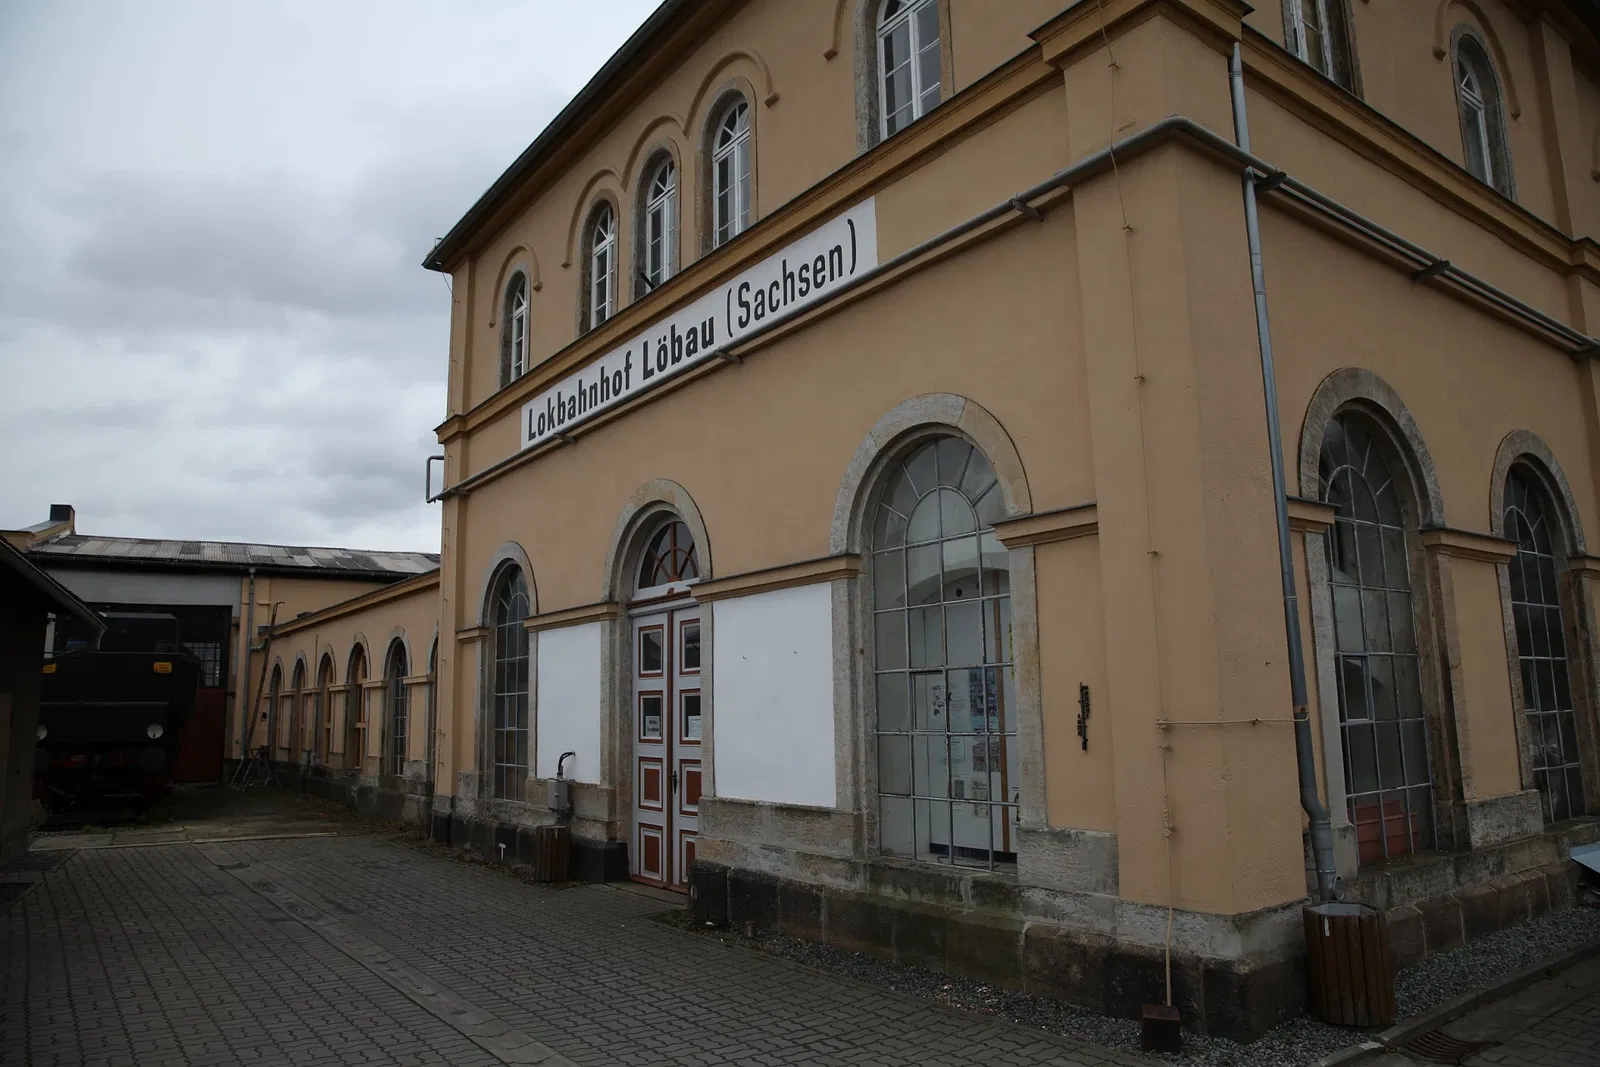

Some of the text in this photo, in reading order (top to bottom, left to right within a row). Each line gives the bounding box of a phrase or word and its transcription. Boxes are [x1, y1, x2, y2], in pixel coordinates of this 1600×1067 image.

[528, 218, 857, 441] Lokbahnhof Löbau (Sachsen)
